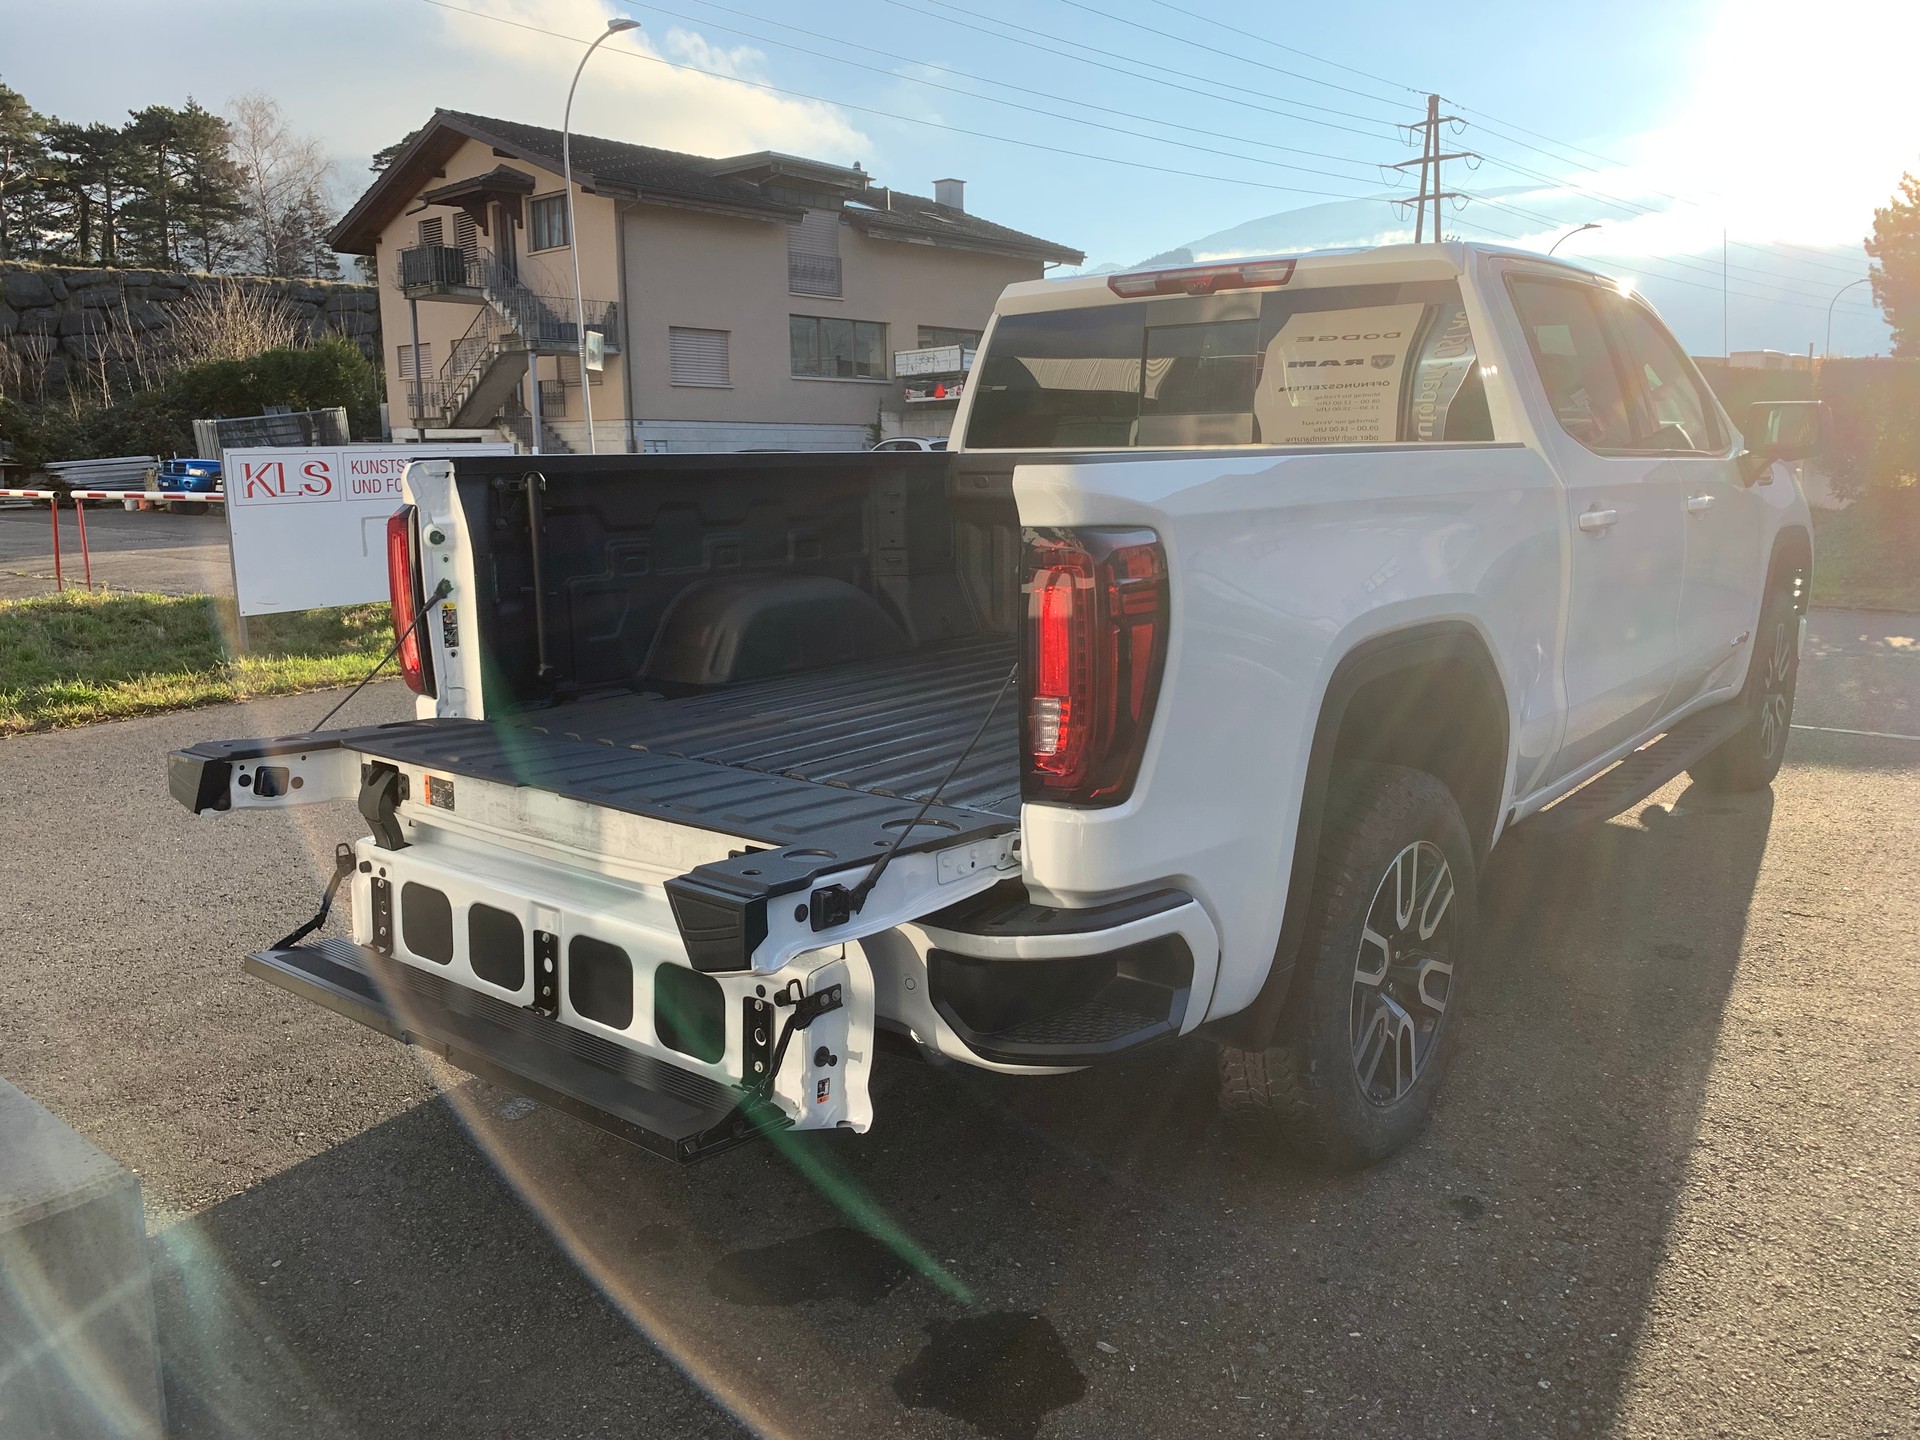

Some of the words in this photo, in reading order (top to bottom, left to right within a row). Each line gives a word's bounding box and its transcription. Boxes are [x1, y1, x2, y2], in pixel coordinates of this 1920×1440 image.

[350, 458, 411, 475] KUNSTS
[240, 460, 333, 499] KLS
[352, 478, 382, 494] UND
